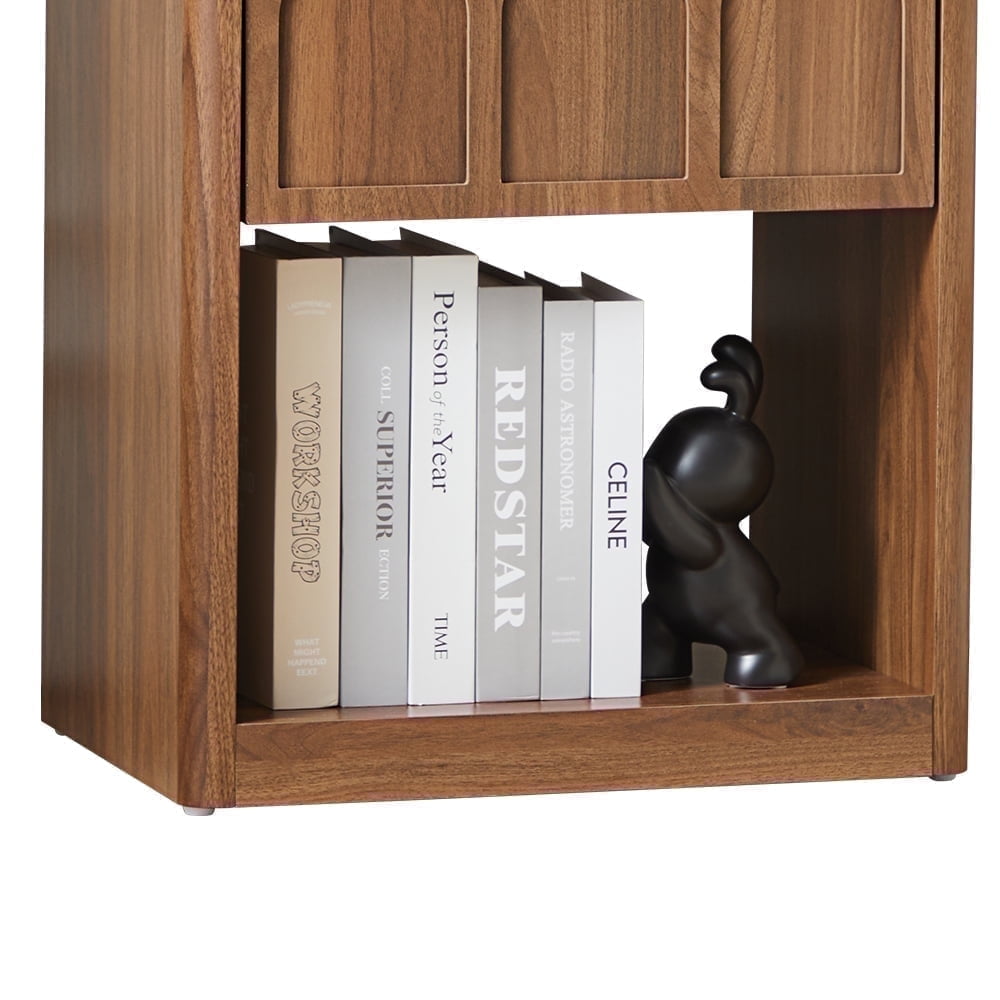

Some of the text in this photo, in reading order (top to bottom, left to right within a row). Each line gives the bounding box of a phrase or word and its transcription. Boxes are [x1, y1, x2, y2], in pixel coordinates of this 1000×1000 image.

[429, 290, 455, 494] Person of the Year
[559, 331, 575, 531] RADIO ASTRONOMER
[290, 381, 321, 584] WORKSHOP
[375, 410, 395, 541] SUPERIOR
[494, 365, 527, 633] REDSTAR
[607, 461, 628, 549] CELINE
[379, 548, 390, 600] ECTION
[434, 612, 449, 661] TIME
